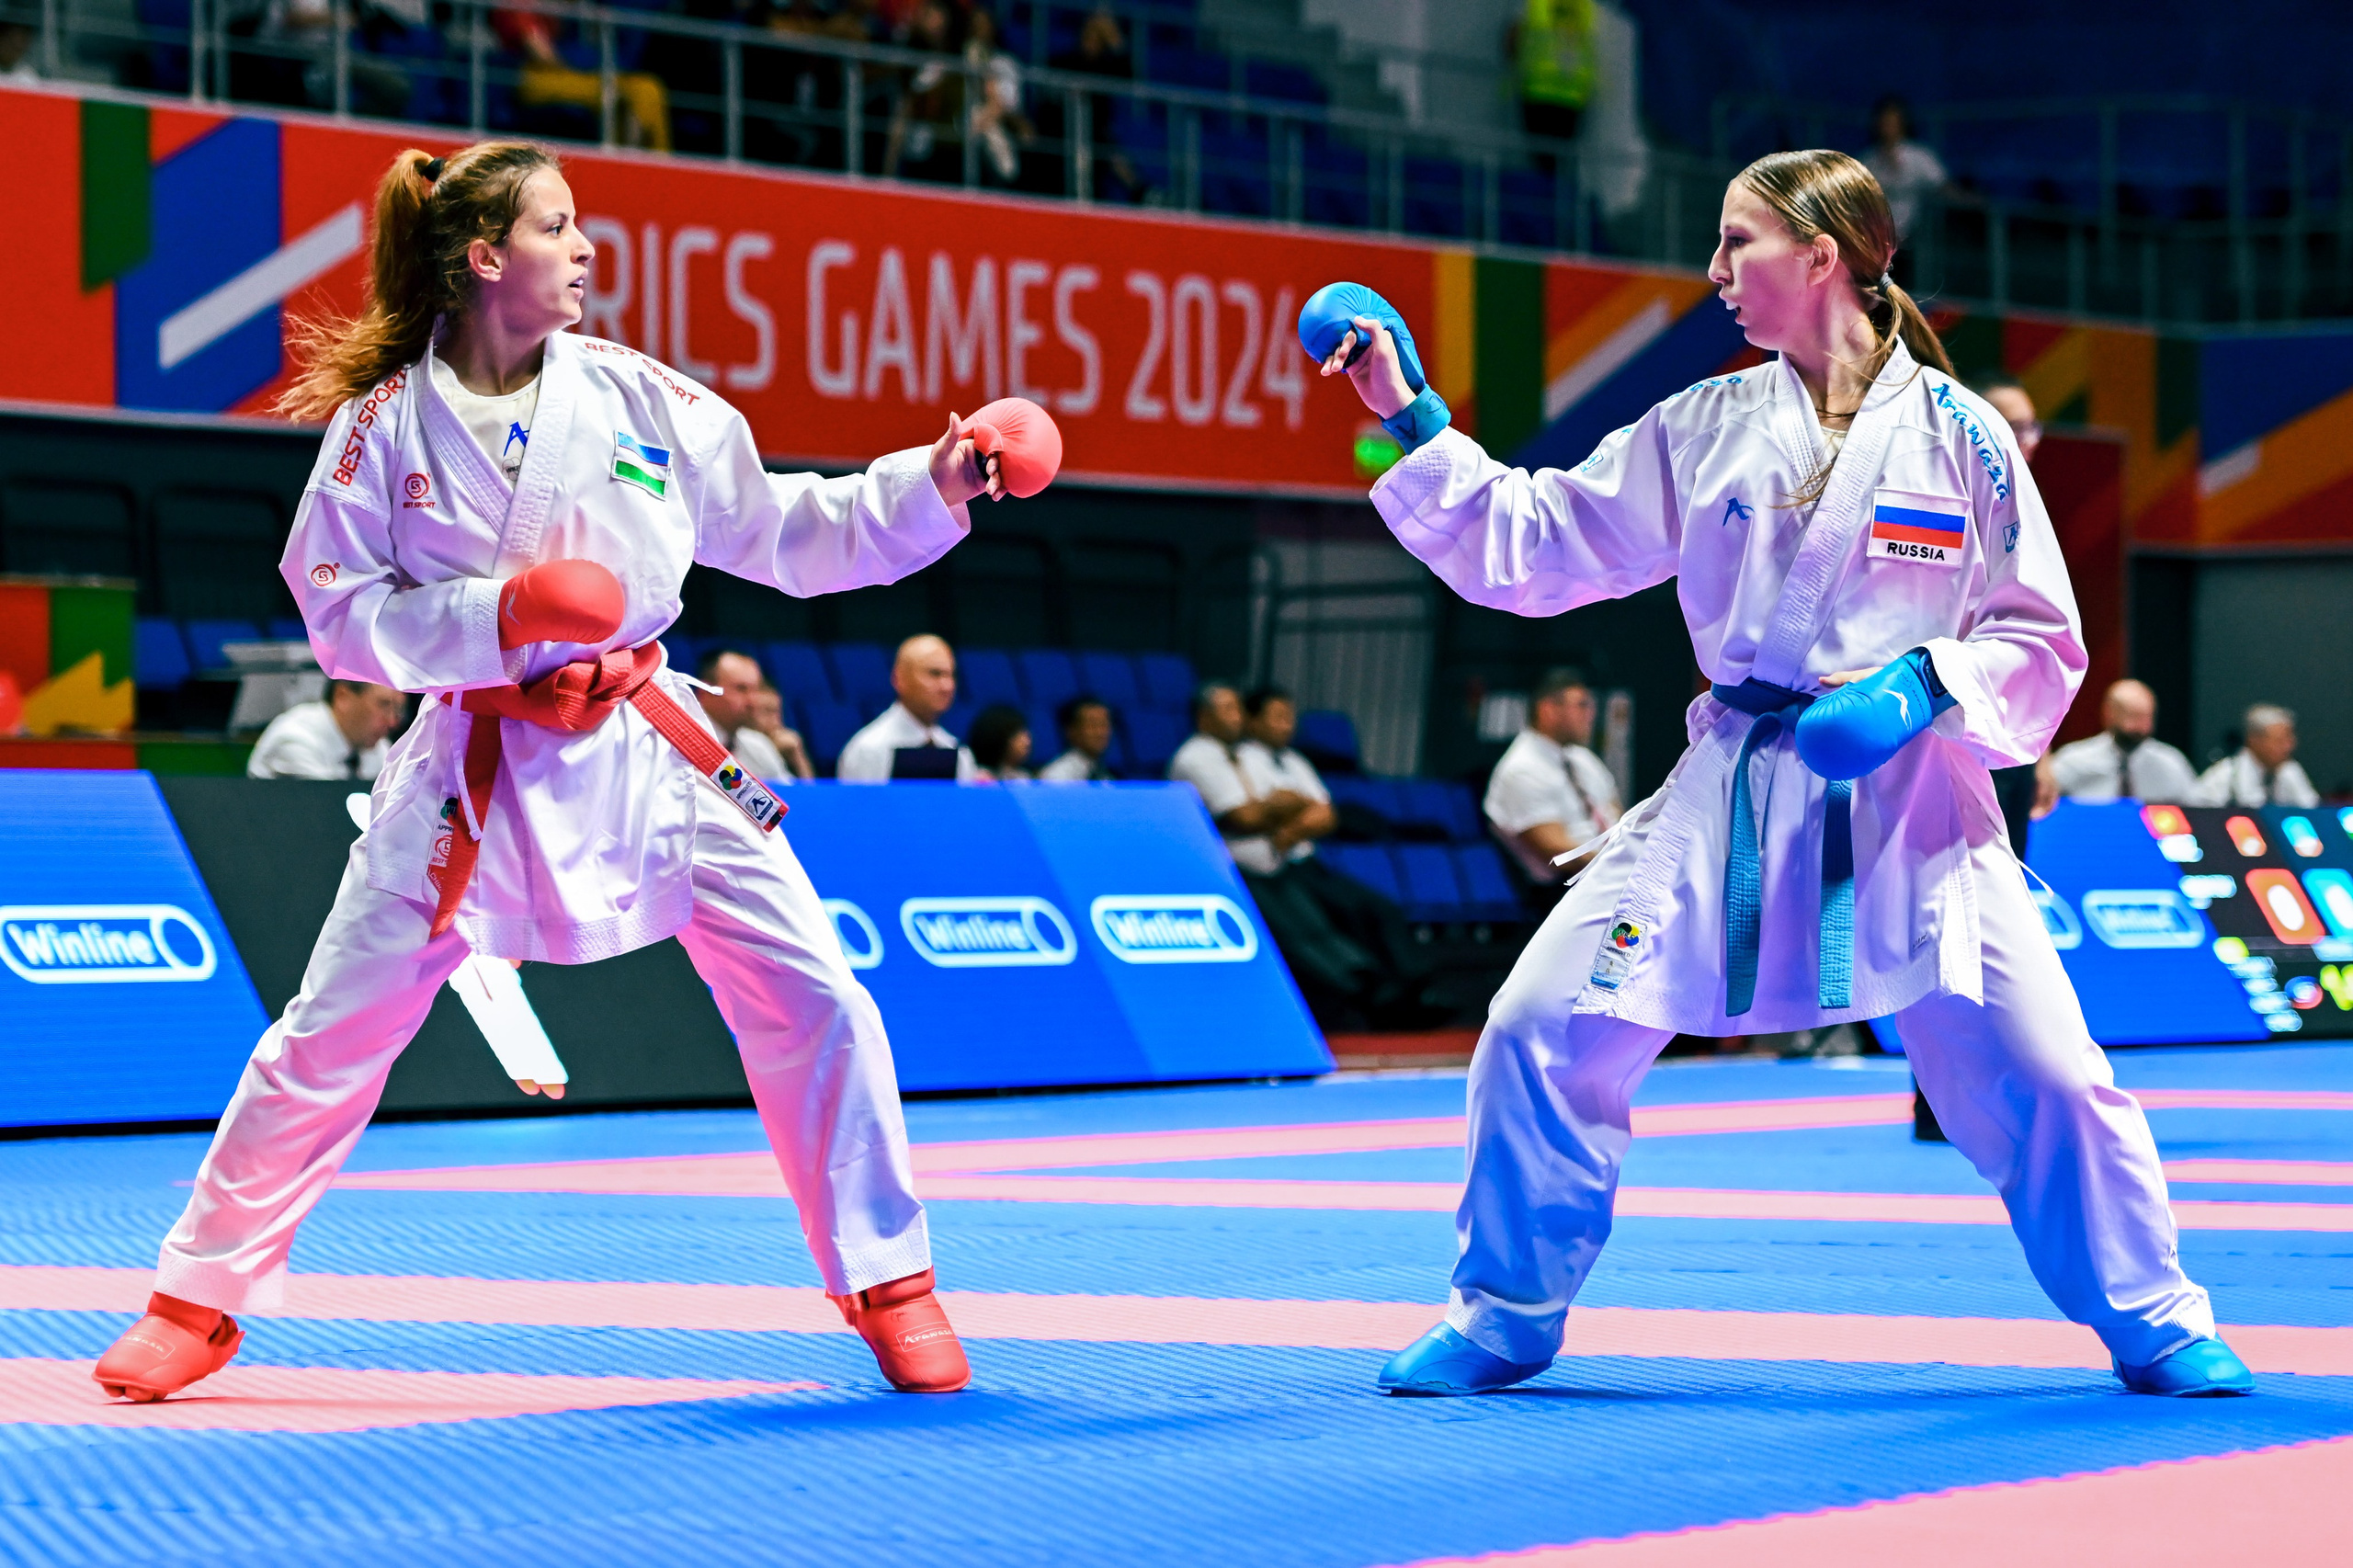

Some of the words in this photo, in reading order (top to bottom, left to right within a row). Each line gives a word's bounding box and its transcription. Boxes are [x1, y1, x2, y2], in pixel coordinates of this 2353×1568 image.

[580, 216, 777, 392] RICS
[806, 239, 1103, 415] GAMES
[1123, 267, 1307, 432] 2024
[332, 426, 366, 487] BEST
[357, 369, 406, 430] SPORT
[1931, 382, 2010, 505] Arawaza
[1887, 541, 1945, 562] RUSSIA
[6, 923, 157, 965] Winline
